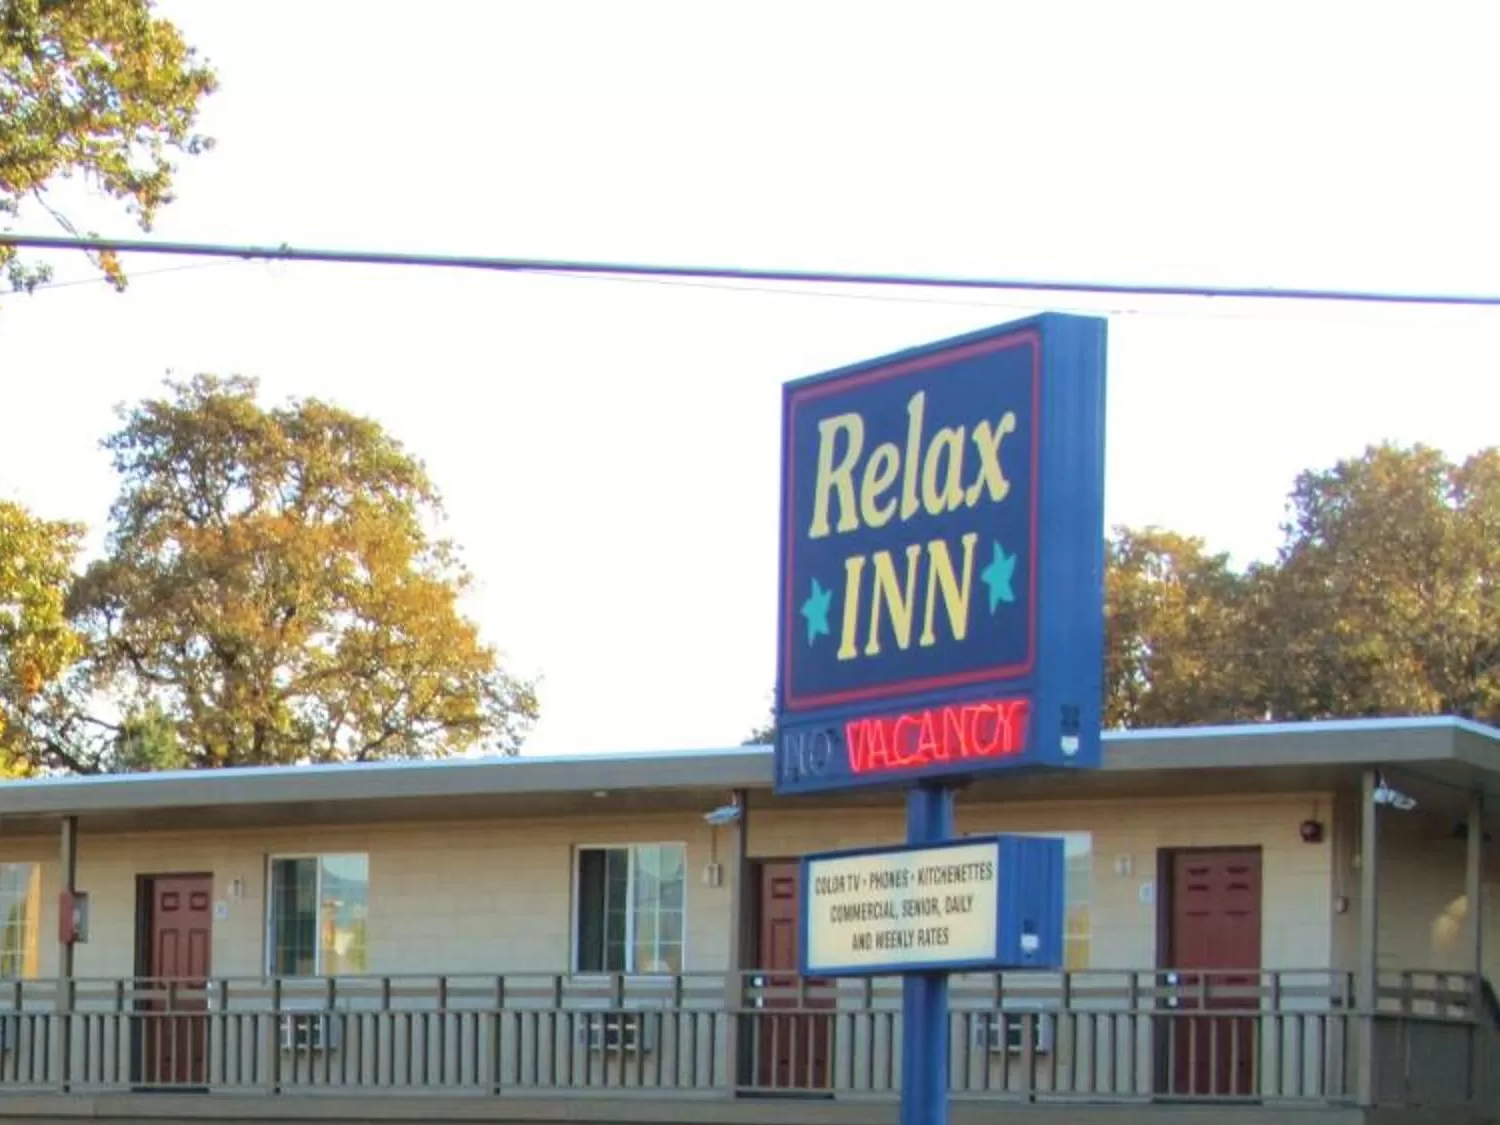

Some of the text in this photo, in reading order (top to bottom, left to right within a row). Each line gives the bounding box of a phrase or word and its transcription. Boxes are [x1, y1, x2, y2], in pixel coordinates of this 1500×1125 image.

[808, 390, 1016, 539] Relax
[836, 533, 978, 661] INN
[783, 701, 1027, 779] NO VACANCY
[815, 861, 993, 896] COLOR TV PHONES KITCHENETTES
[829, 895, 974, 924] COMMERCIAL, SENIOR, DAILY
[852, 927, 950, 951] AND WEEKLY RATES
